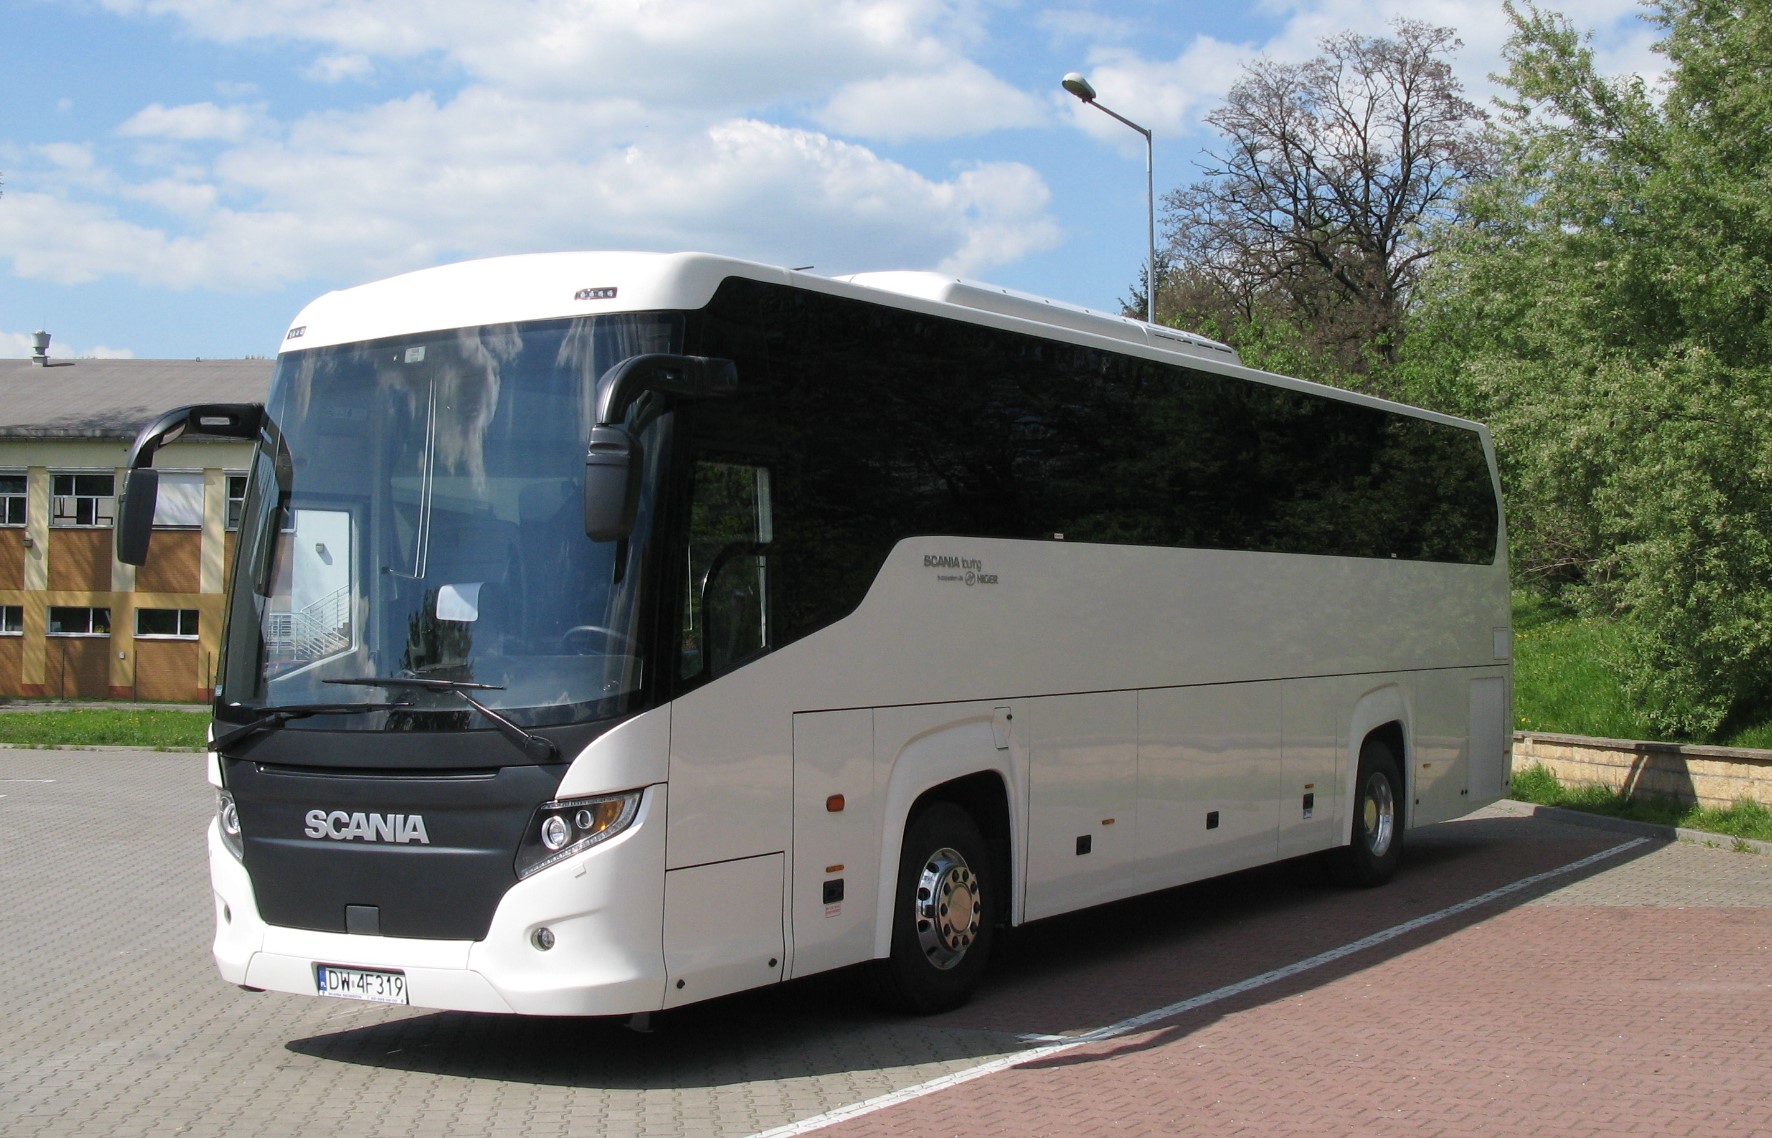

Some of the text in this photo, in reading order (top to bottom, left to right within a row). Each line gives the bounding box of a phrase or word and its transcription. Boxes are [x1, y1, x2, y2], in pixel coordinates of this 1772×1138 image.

[923, 554, 960, 569] SCANIA
[304, 809, 430, 844] SCANIA
[328, 969, 404, 997] DW 4F319
